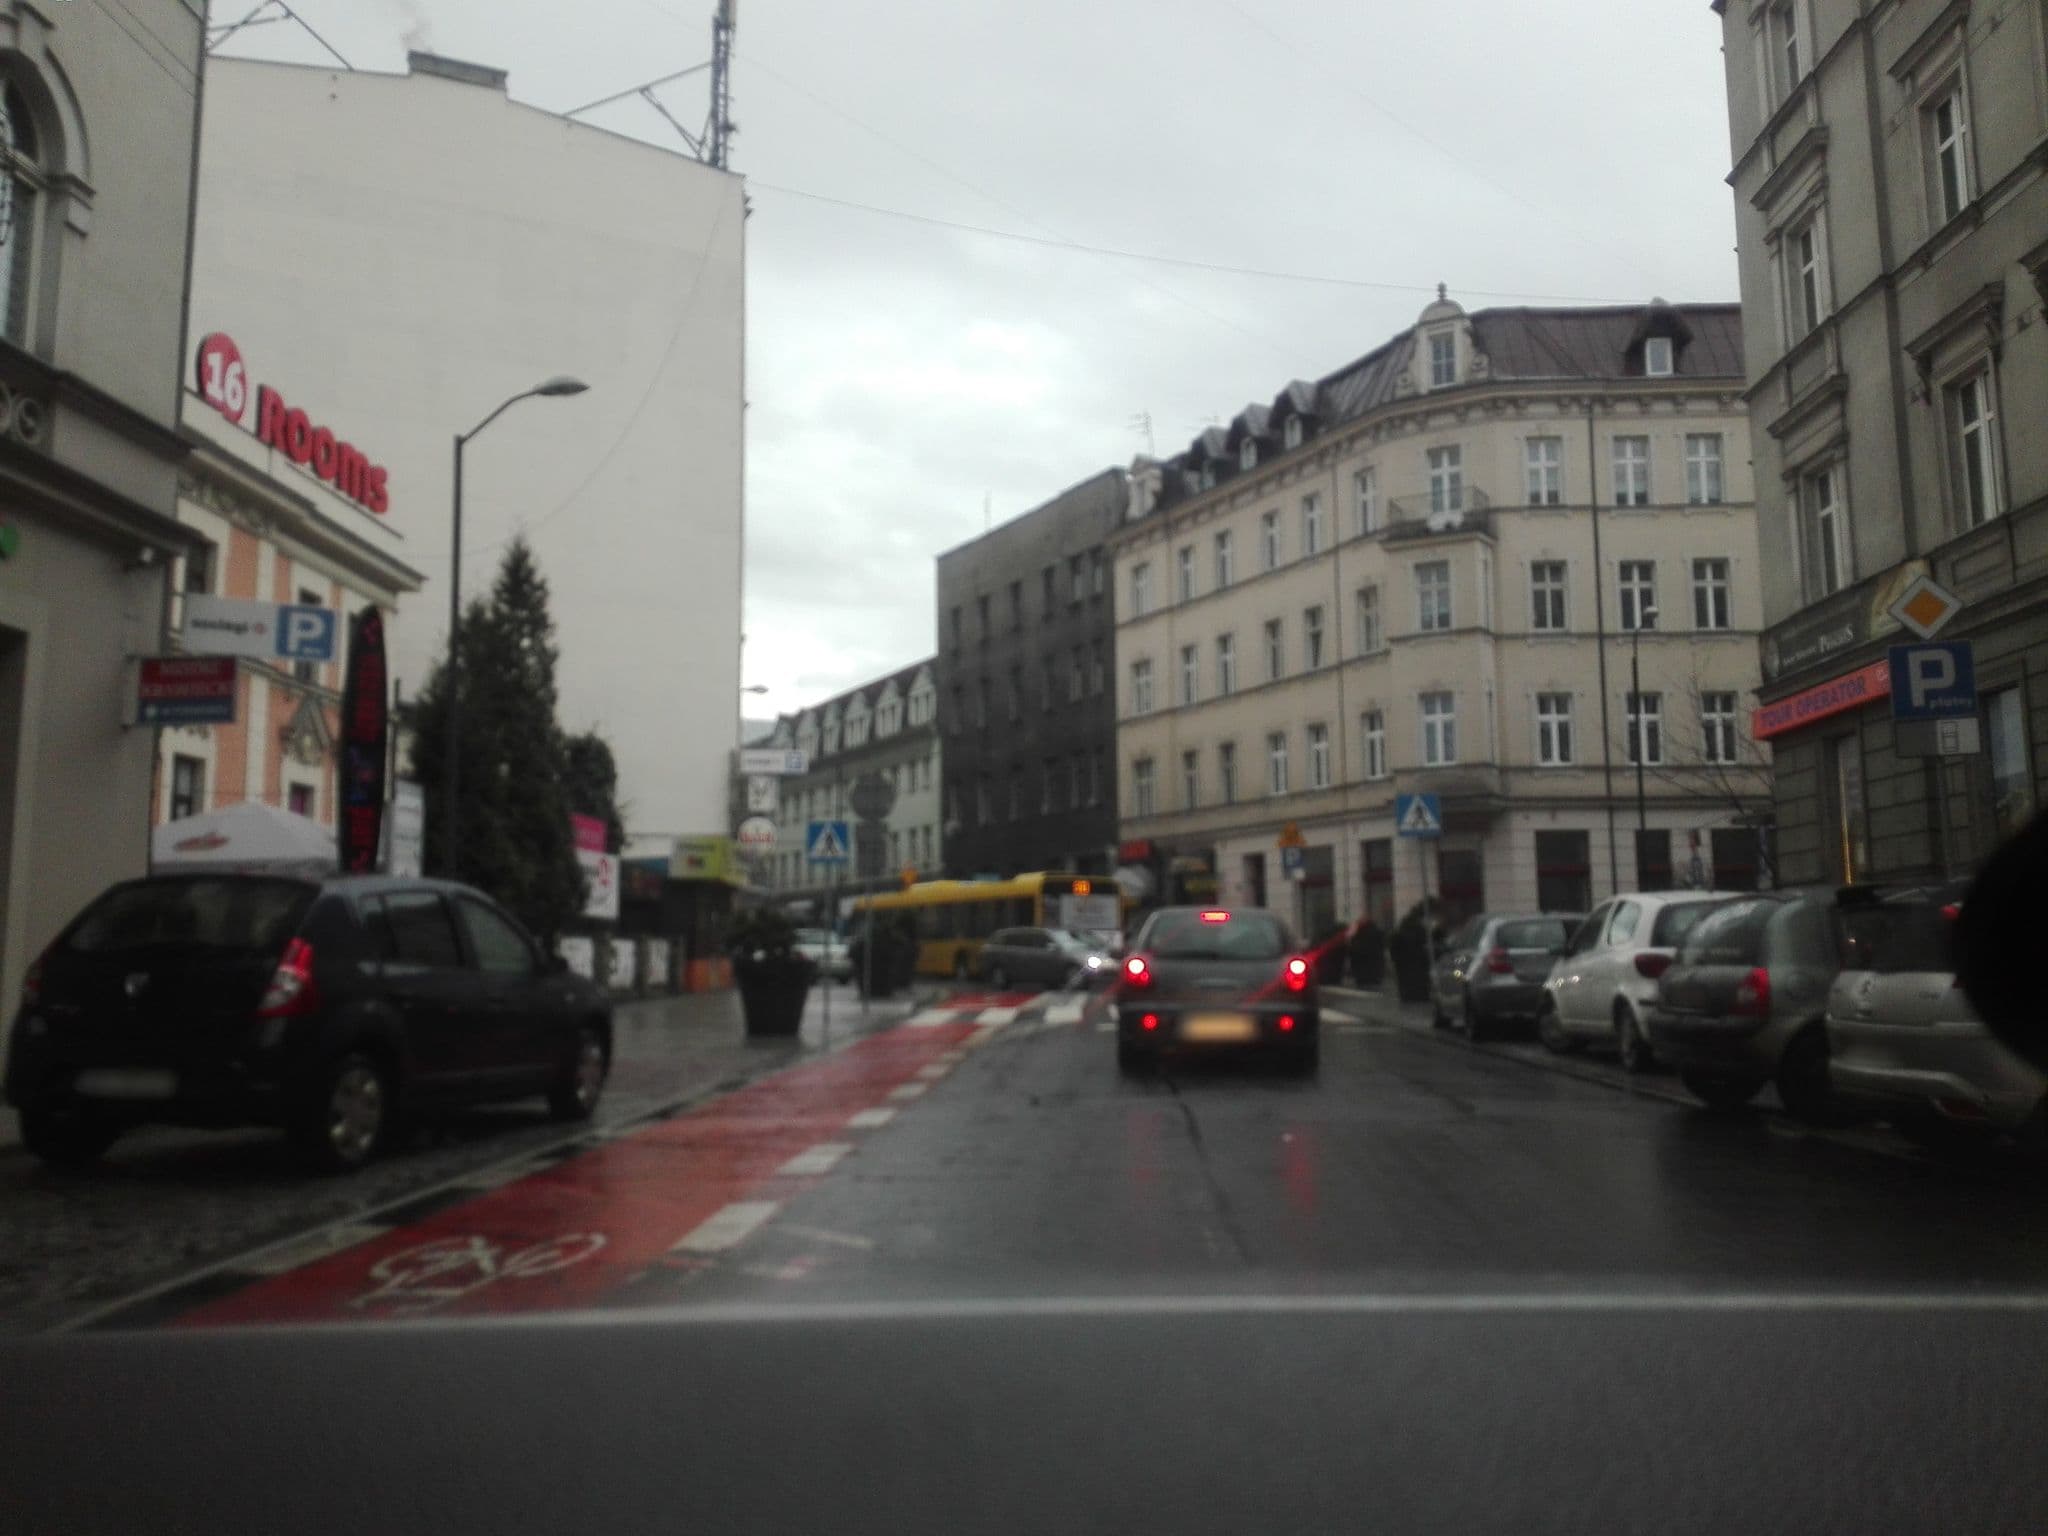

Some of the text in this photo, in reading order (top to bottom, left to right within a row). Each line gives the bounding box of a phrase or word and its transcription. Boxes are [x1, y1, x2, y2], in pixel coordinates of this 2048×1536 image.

[206, 352, 388, 514] 16 Rooms
[287, 612, 325, 652] P
[1760, 676, 1866, 728] TOUR OPERATOR
[1907, 649, 1956, 709] P
